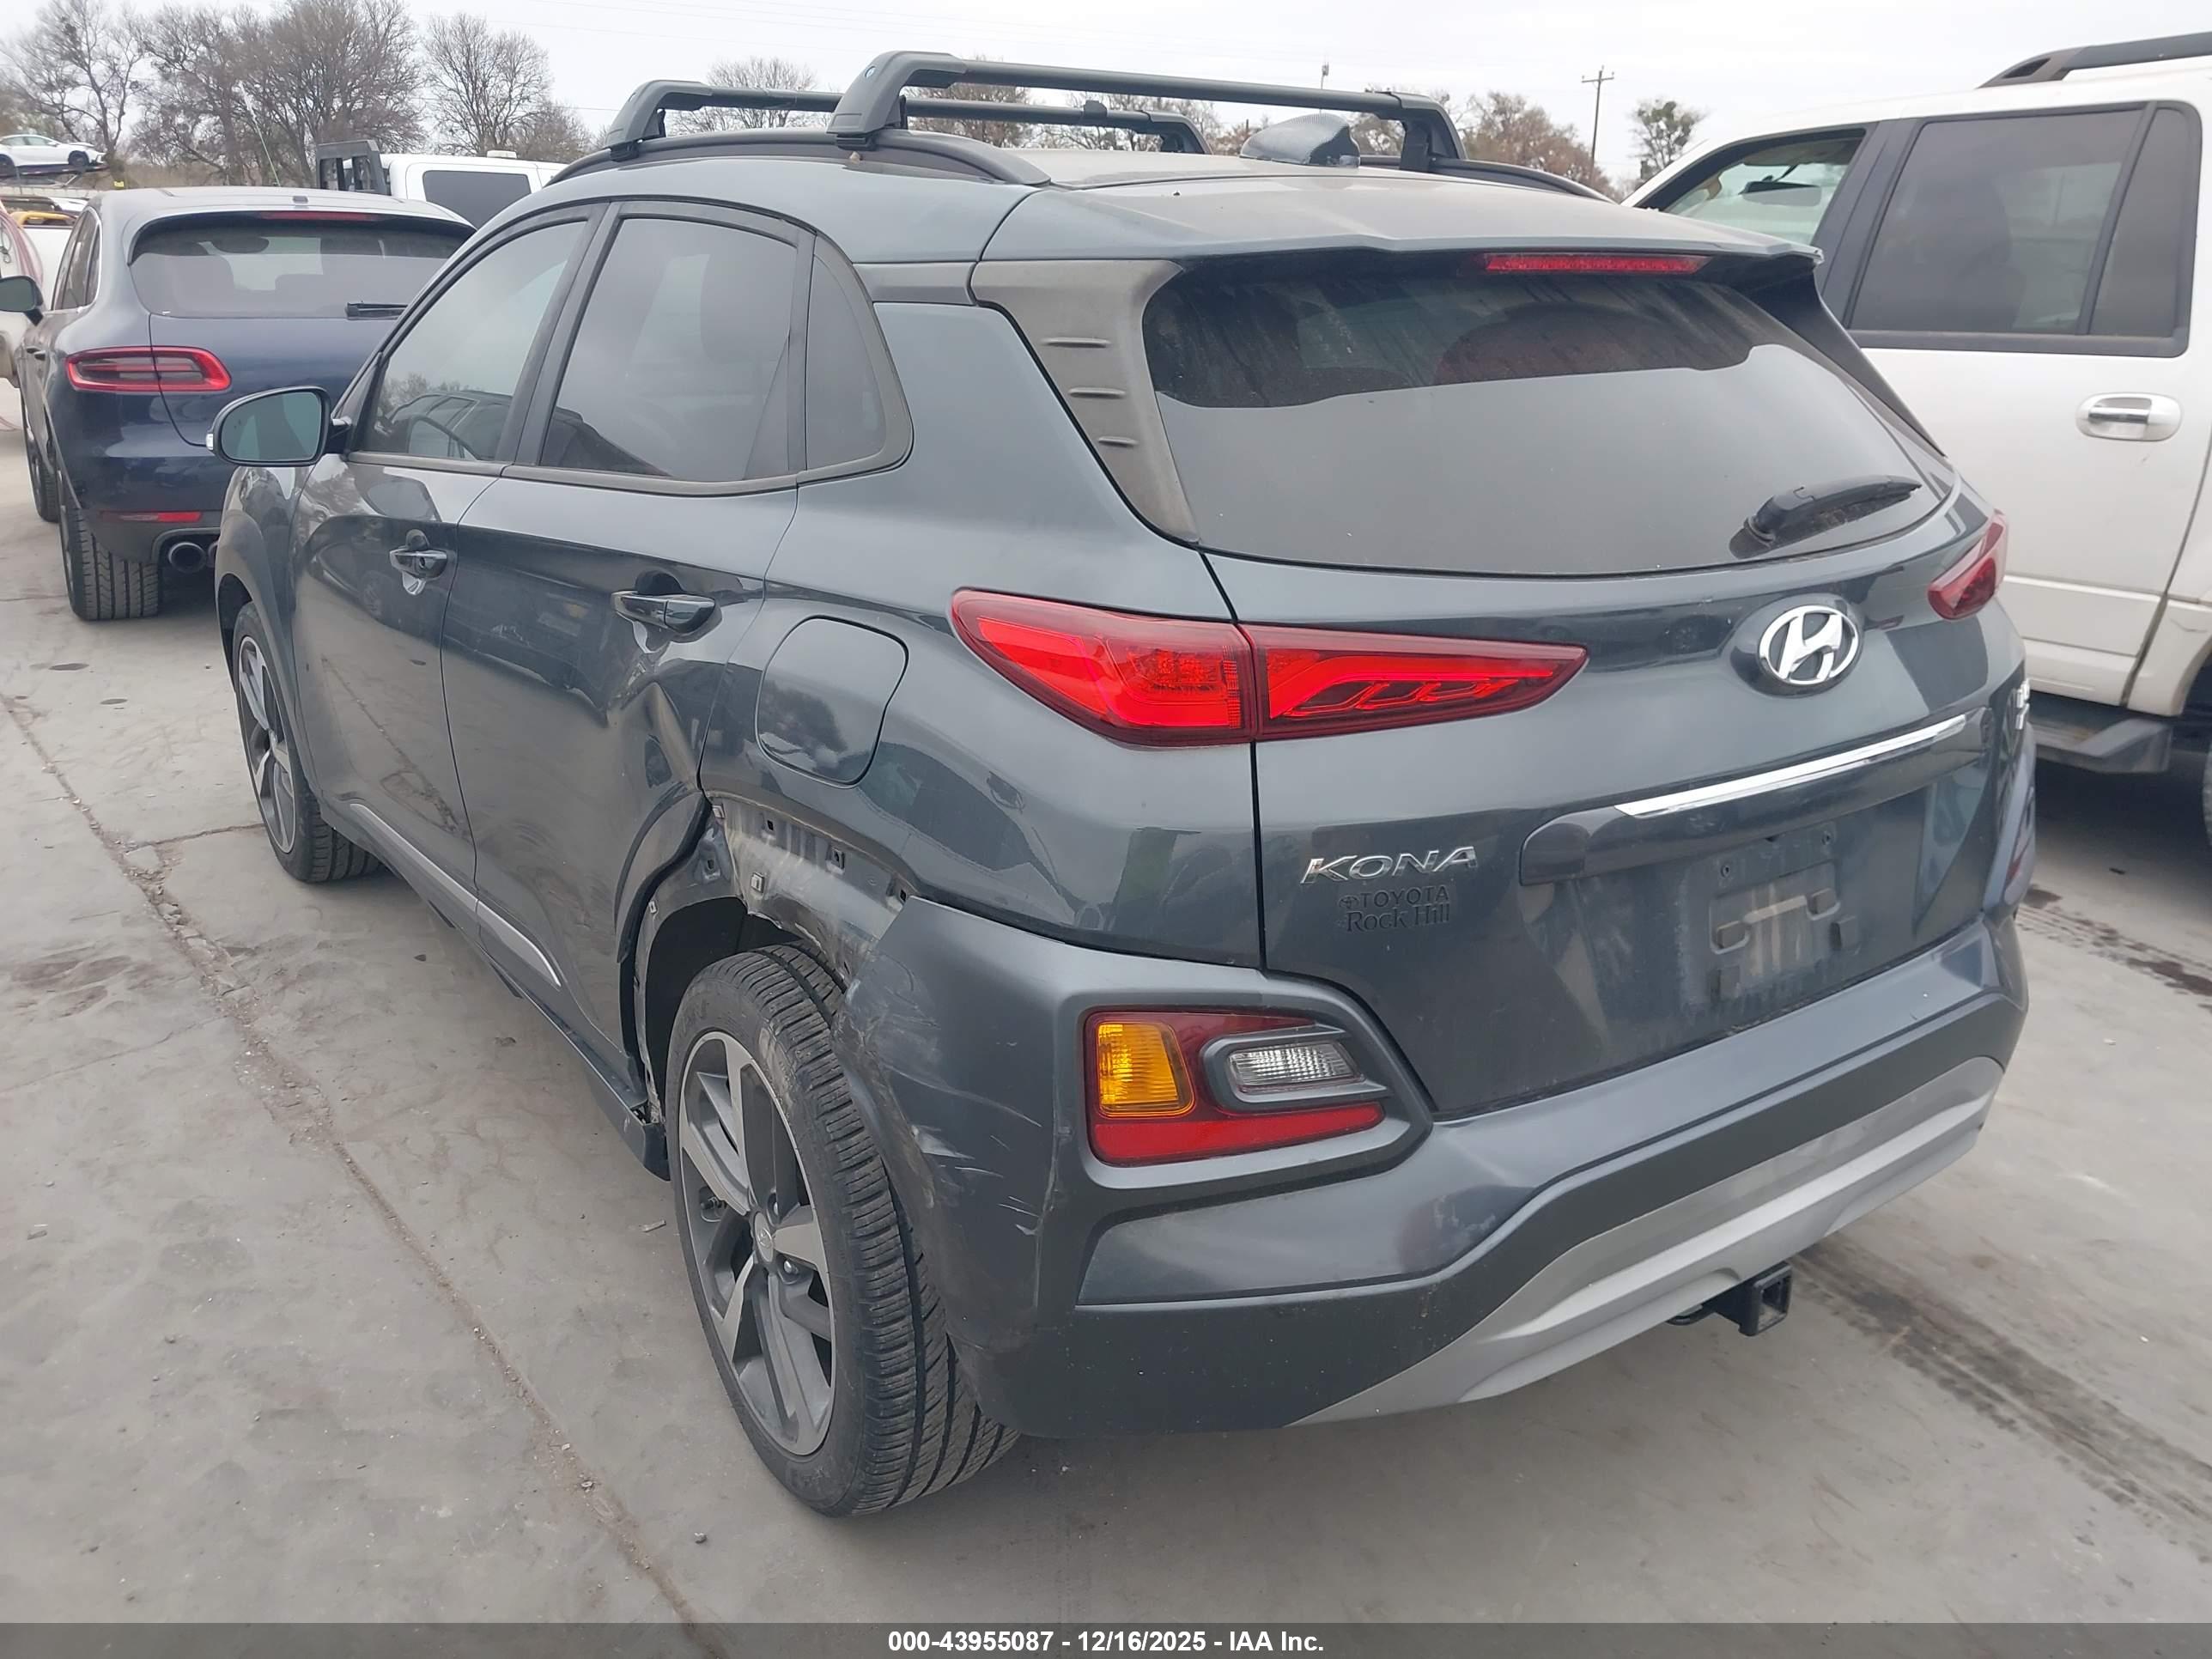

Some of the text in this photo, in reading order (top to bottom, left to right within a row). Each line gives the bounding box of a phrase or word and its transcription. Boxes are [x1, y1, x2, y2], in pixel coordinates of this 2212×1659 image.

[1300, 846, 1478, 884] KONA
[1360, 885, 1449, 908] TOYOTA
[1346, 902, 1450, 932] Rock Hill
